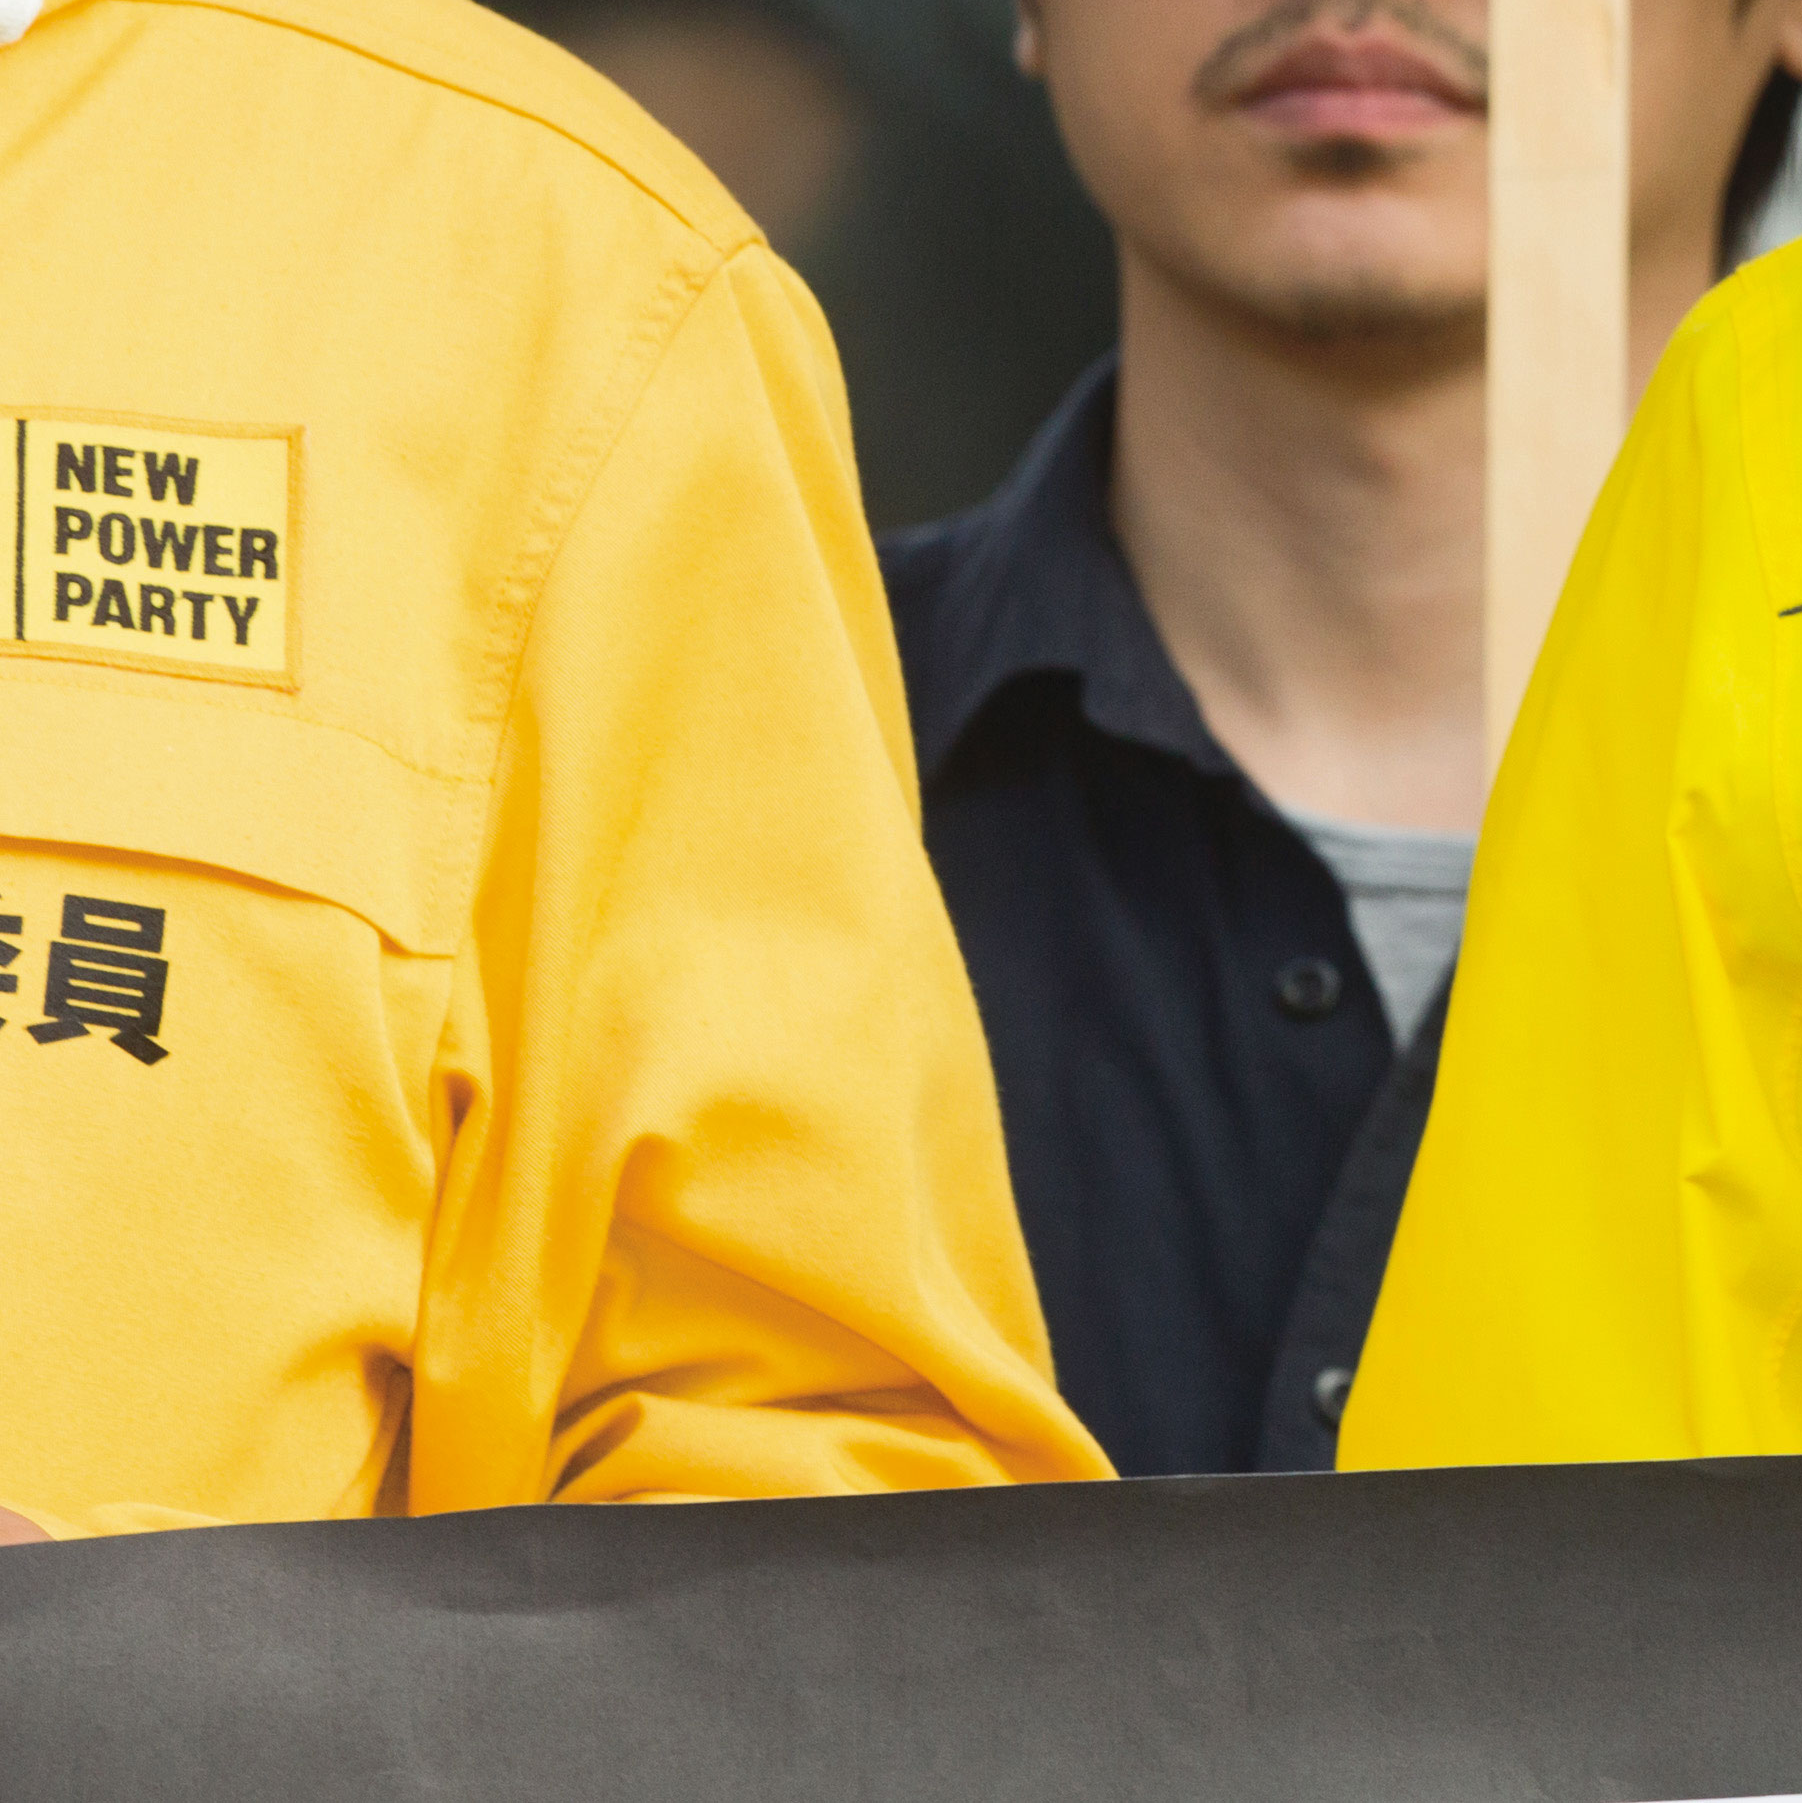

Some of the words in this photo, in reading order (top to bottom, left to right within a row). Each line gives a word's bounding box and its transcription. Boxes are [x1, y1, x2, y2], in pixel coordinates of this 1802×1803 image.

[55, 442, 199, 505] NEW
[54, 505, 280, 580] POWER
[54, 571, 260, 646] PARTY
[0, 893, 170, 1066] 員
